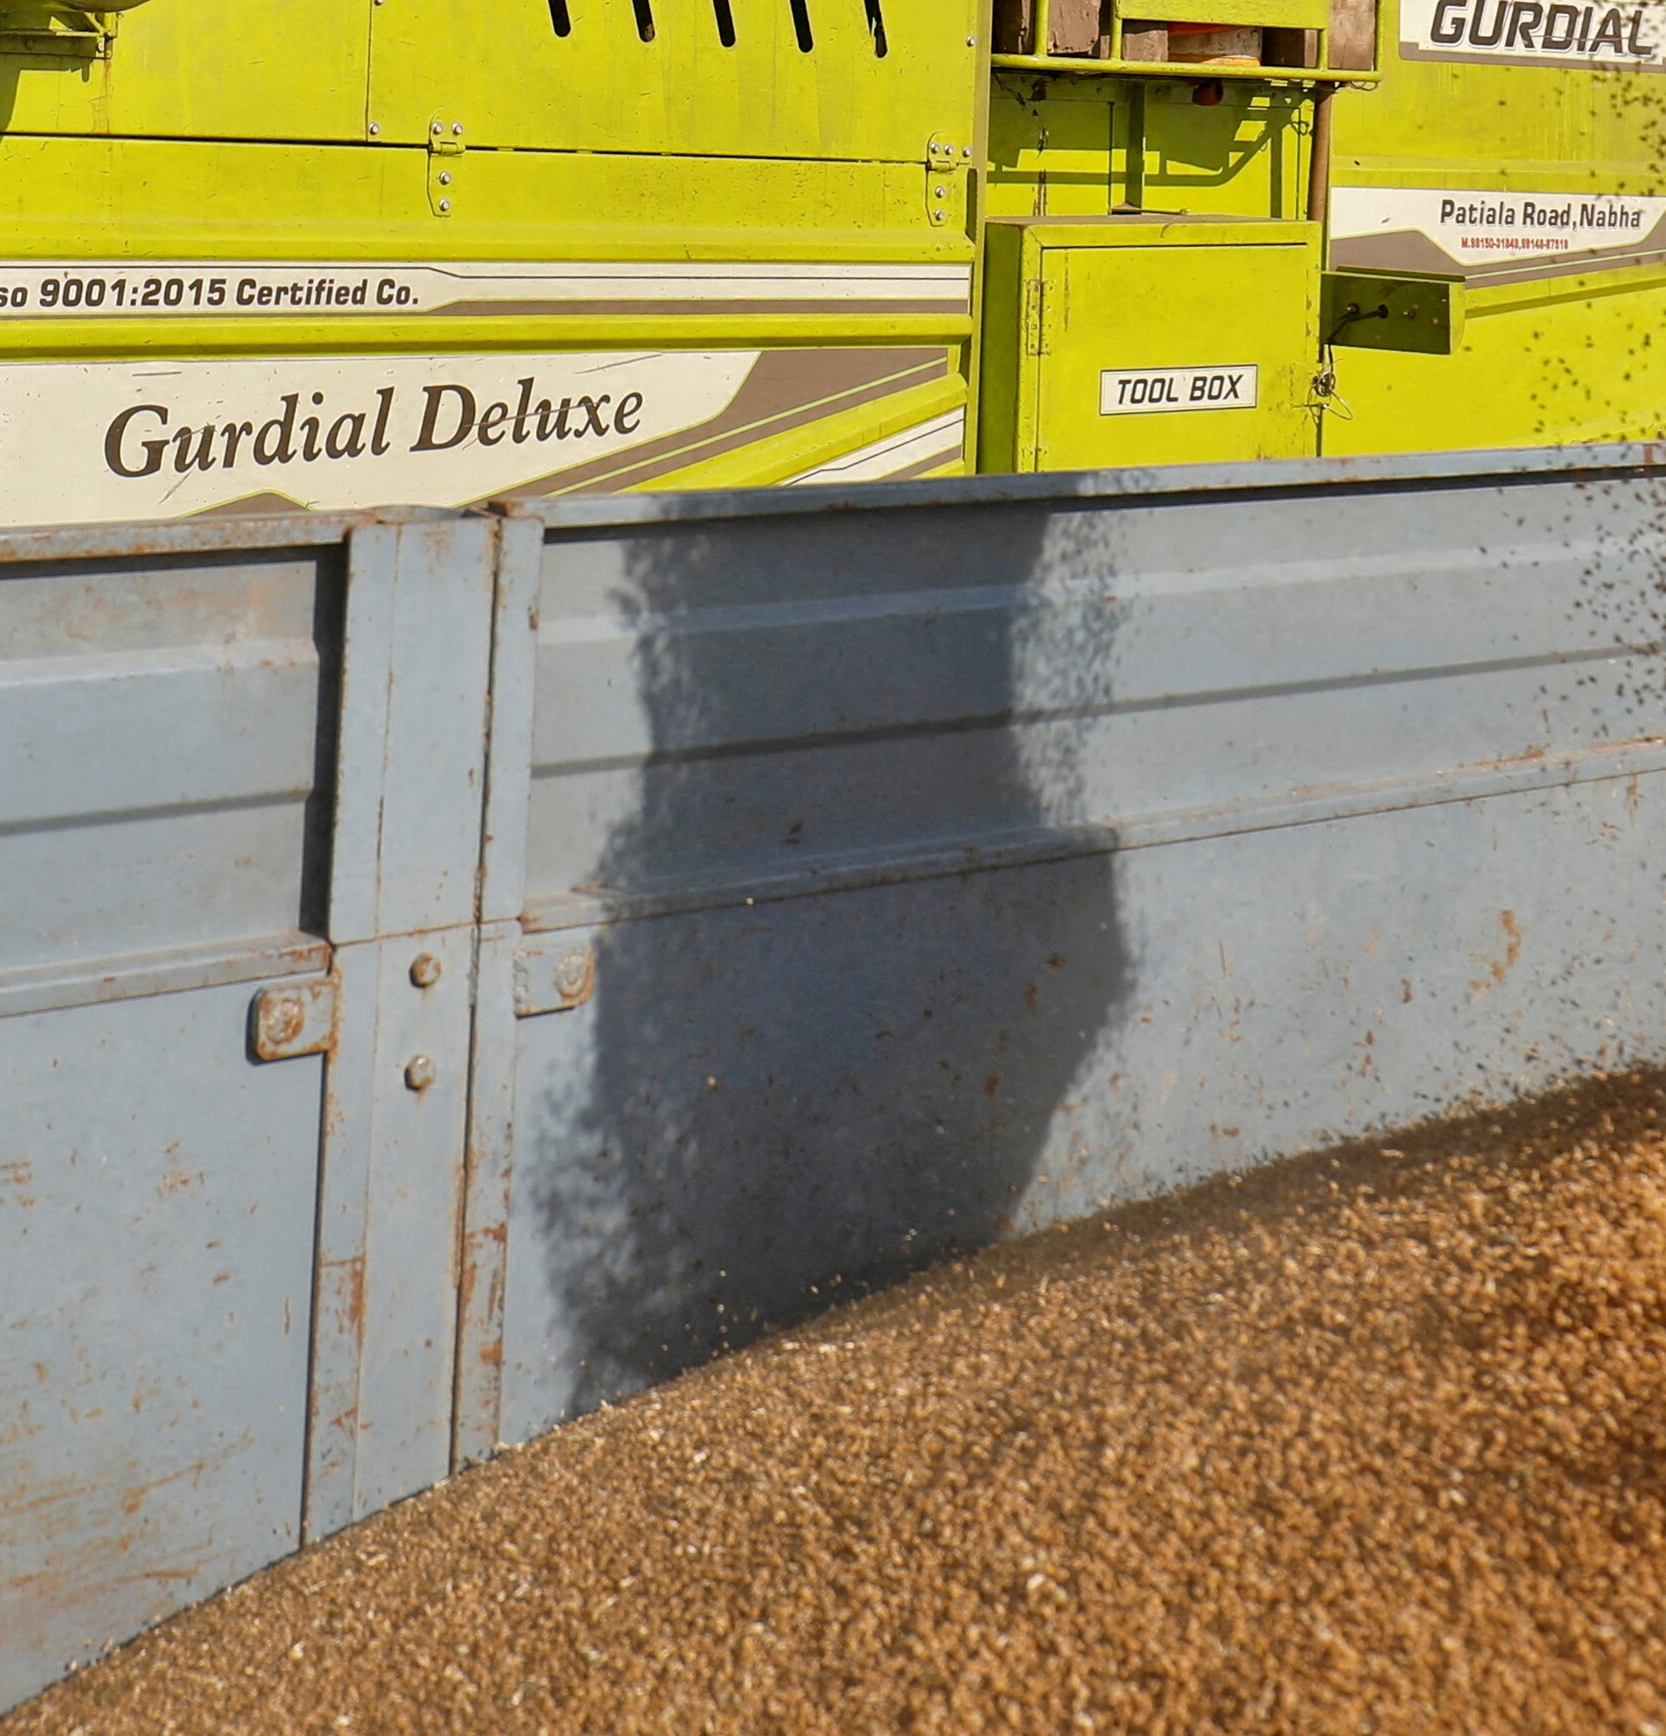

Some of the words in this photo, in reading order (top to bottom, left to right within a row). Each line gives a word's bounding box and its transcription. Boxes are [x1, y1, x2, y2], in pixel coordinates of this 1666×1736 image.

[1440, 198, 1515, 225] Patiala
[39, 278, 228, 308] 9001:2015
[235, 277, 367, 307] Certified
[375, 277, 421, 306] Co.
[1117, 377, 1179, 405] TOOL
[1189, 374, 1244, 401] BOX
[102, 386, 397, 478] Gurdial
[409, 376, 644, 453] Deluxe
